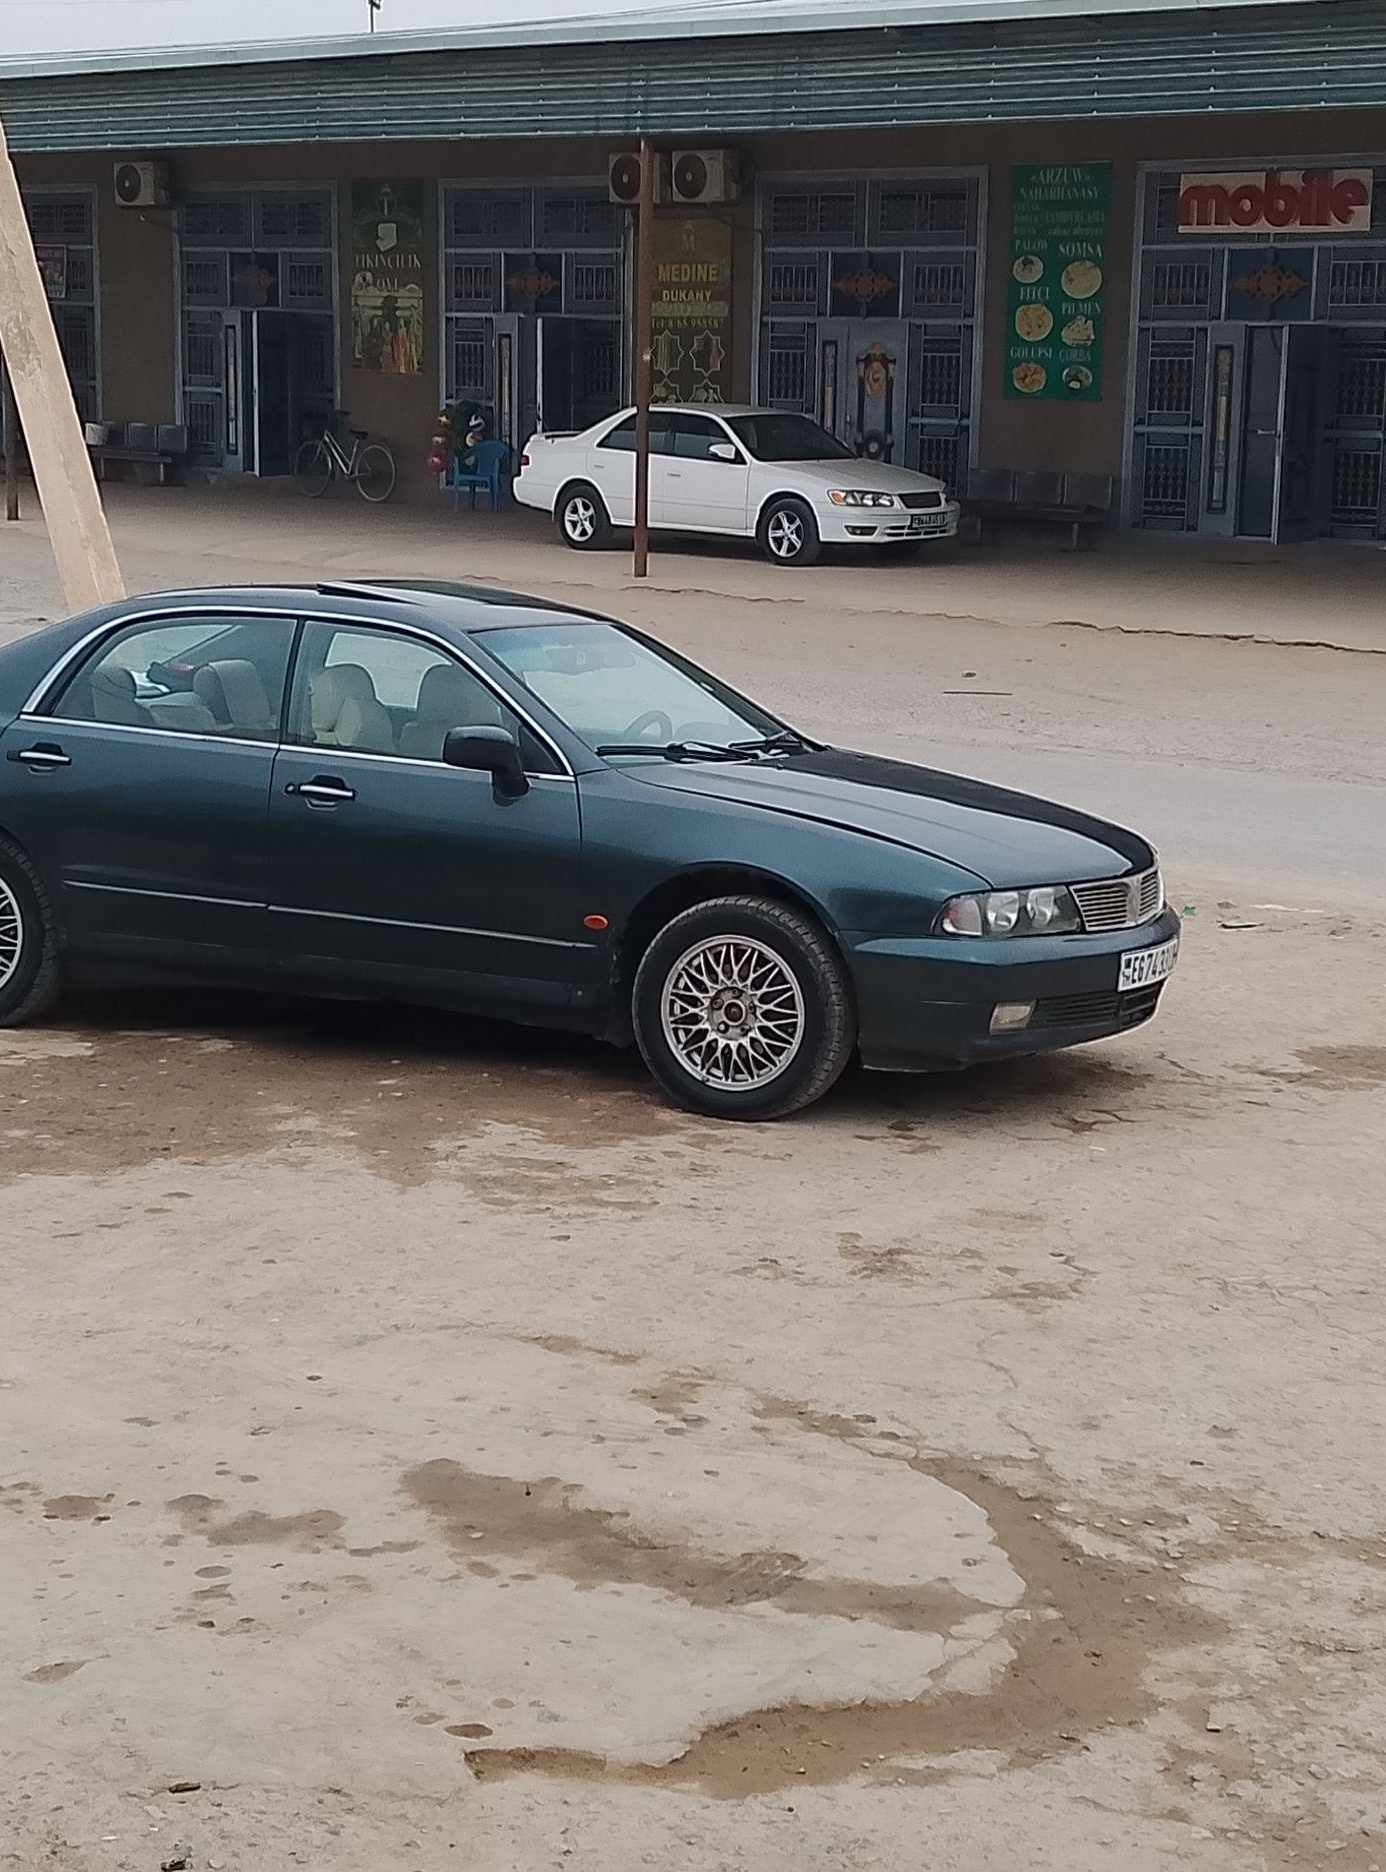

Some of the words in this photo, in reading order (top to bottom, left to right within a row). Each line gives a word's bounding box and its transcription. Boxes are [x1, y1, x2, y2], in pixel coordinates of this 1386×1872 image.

[1176, 168, 1369, 226] mobile
[1059, 242, 1103, 258] SOMSA
[657, 263, 719, 282] MEDINE
[662, 289, 712, 302] DUKANY
